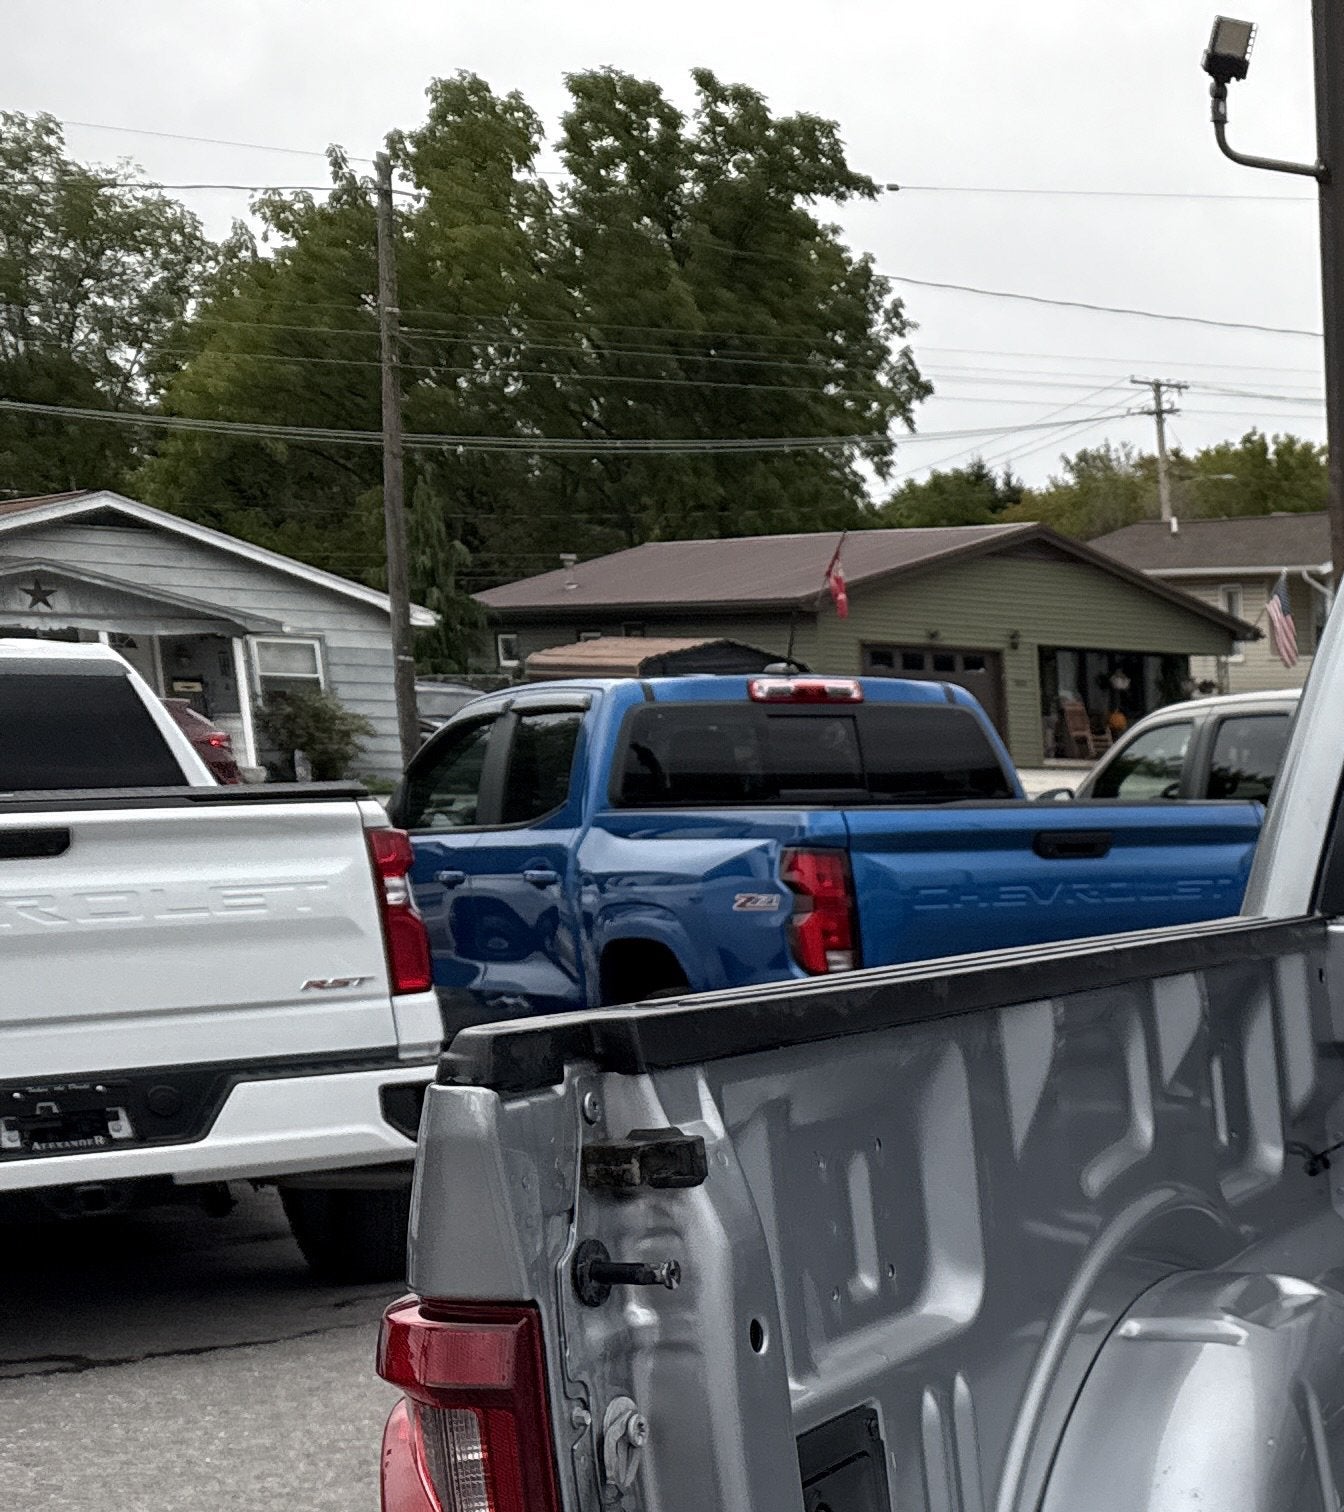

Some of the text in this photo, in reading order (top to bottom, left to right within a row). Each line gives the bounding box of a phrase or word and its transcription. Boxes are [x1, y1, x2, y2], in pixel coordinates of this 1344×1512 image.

[732, 893, 780, 911] Z71
[912, 878, 1233, 910] CHEVROLET
[300, 975, 376, 991] RST
